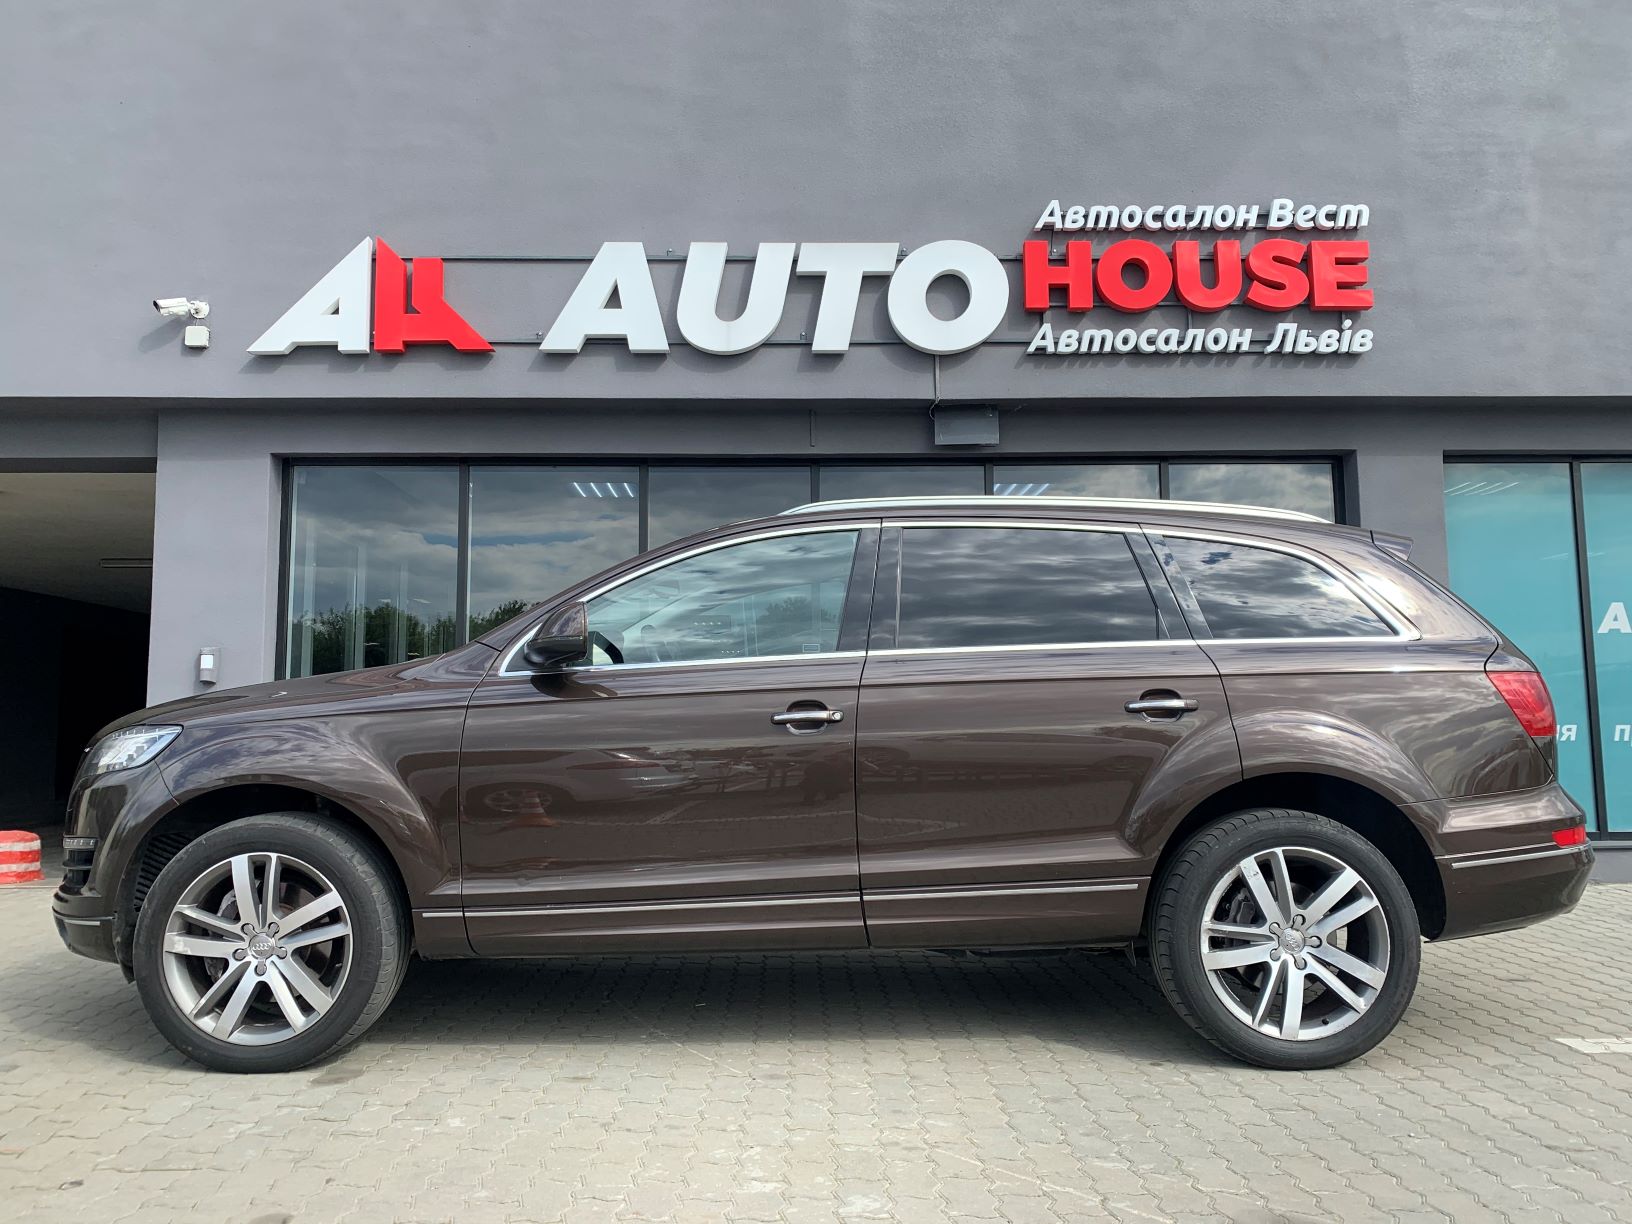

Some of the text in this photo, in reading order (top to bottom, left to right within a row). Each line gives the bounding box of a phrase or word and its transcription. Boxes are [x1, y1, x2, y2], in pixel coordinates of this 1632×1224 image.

[1034, 198, 1370, 231] Автосалон Вест
[539, 239, 1374, 355] AUTO HOUSE
[1027, 318, 1374, 355] Автосалон Львів
